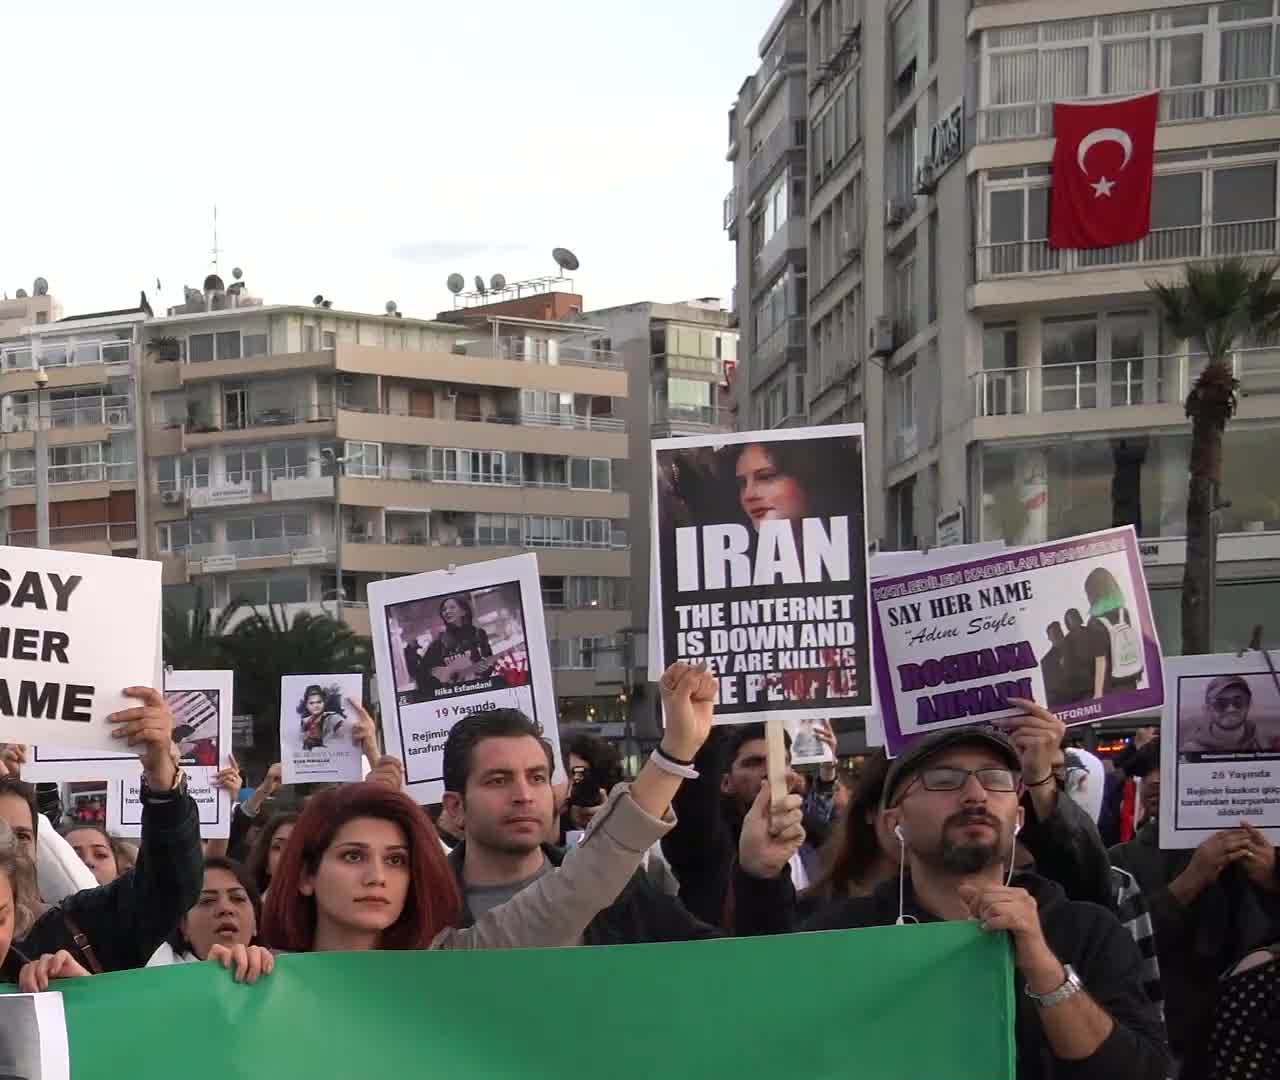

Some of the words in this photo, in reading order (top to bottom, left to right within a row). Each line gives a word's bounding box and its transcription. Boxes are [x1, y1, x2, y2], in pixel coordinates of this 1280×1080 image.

[675, 515, 851, 592] IRAN
[675, 602, 725, 630] THE
[730, 594, 854, 626] INTERNET
[887, 605, 928, 628] SAY
[929, 593, 973, 623] HER
[979, 580, 1033, 609] NAME
[677, 630, 705, 656] IS
[710, 624, 794, 654] DOWN
[799, 621, 856, 649] AND
[733, 651, 774, 673] ARE
[778, 648, 856, 670] KILLING
[435, 709, 449, 719] 19
